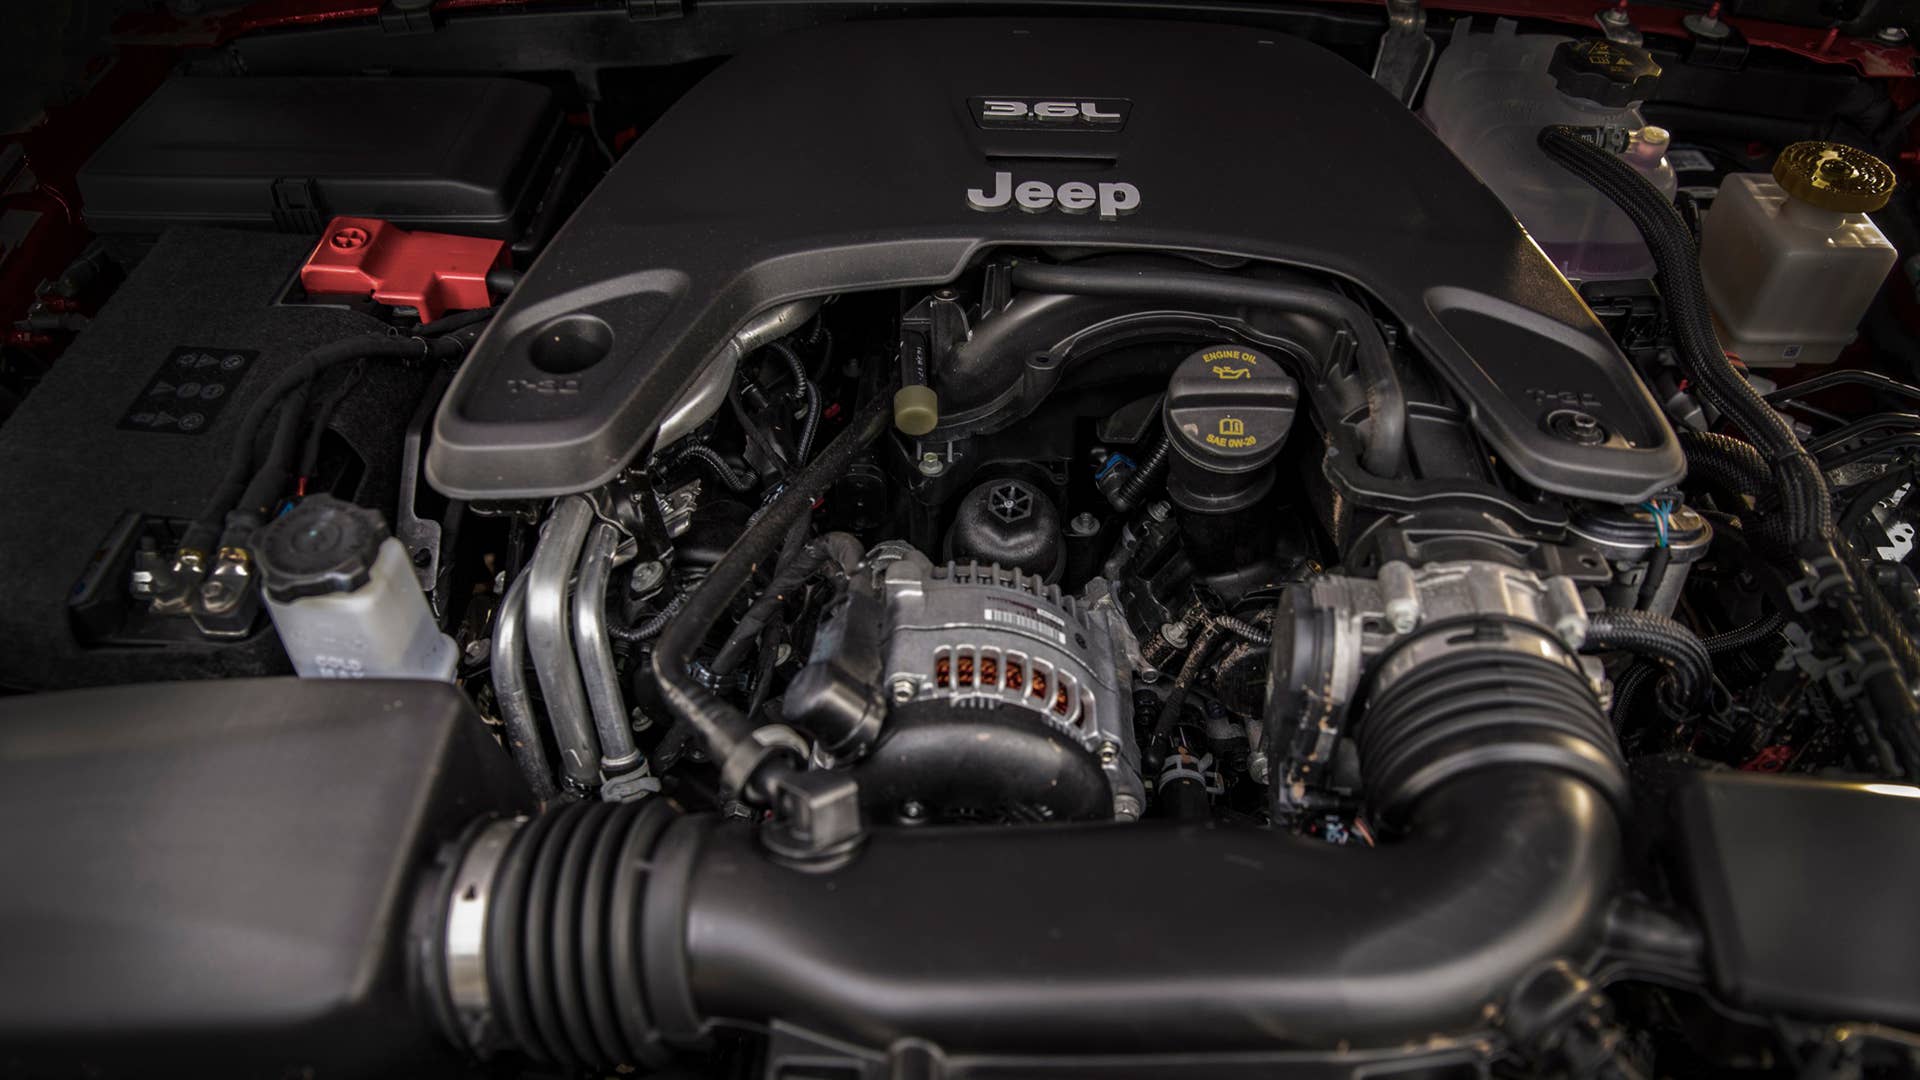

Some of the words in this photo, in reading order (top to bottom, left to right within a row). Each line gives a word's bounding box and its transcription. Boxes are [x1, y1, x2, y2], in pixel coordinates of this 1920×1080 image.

[983, 100, 1121, 123] 3.6L
[967, 171, 1140, 221] Jeep
[1202, 350, 1240, 363] ENGINE
[1241, 352, 1257, 365] OIL
[1206, 434, 1226, 447] SAE
[1228, 435, 1257, 448] 0W-20
